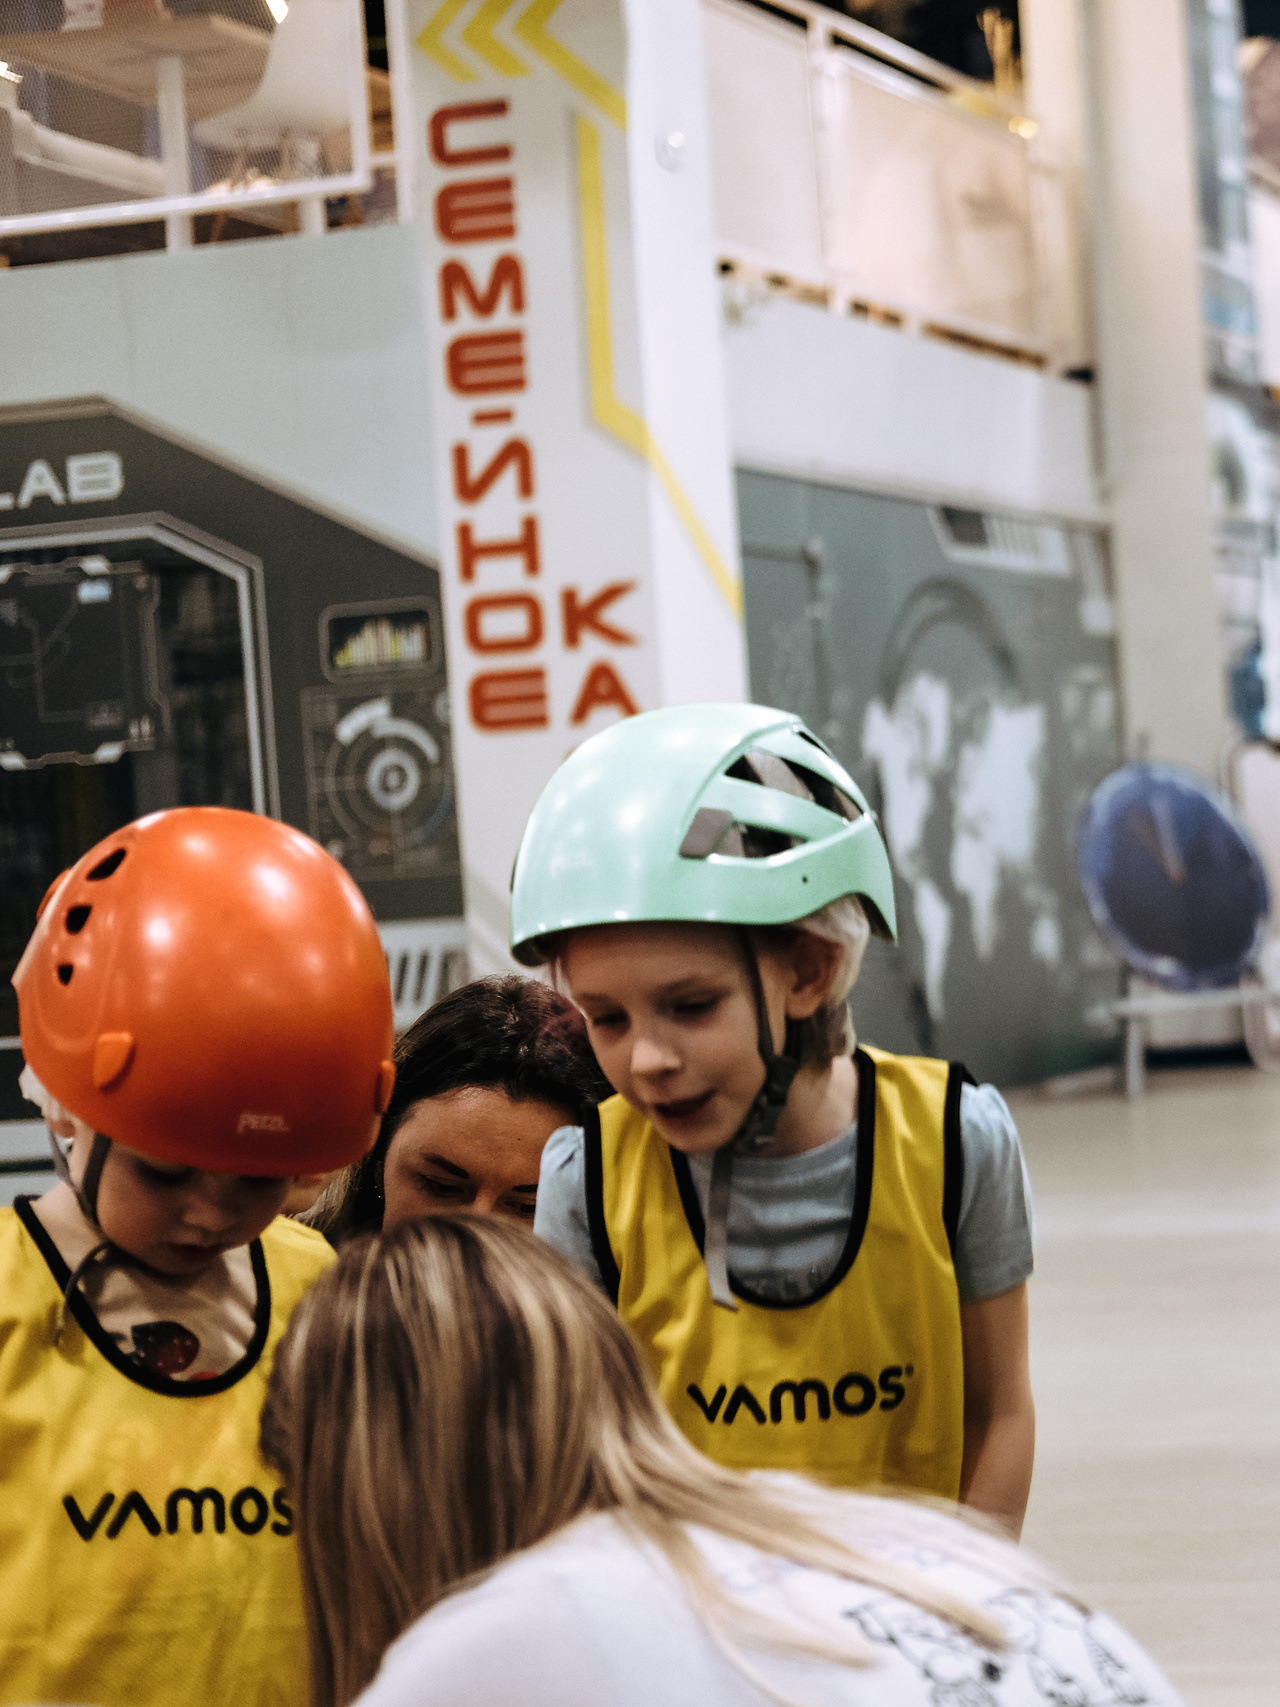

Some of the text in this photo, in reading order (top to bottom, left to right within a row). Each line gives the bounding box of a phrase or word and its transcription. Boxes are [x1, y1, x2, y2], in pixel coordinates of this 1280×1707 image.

[560, 577, 640, 728] КА
[686, 1355, 906, 1424] VAMOS
[62, 1486, 294, 1541] VAMOS
